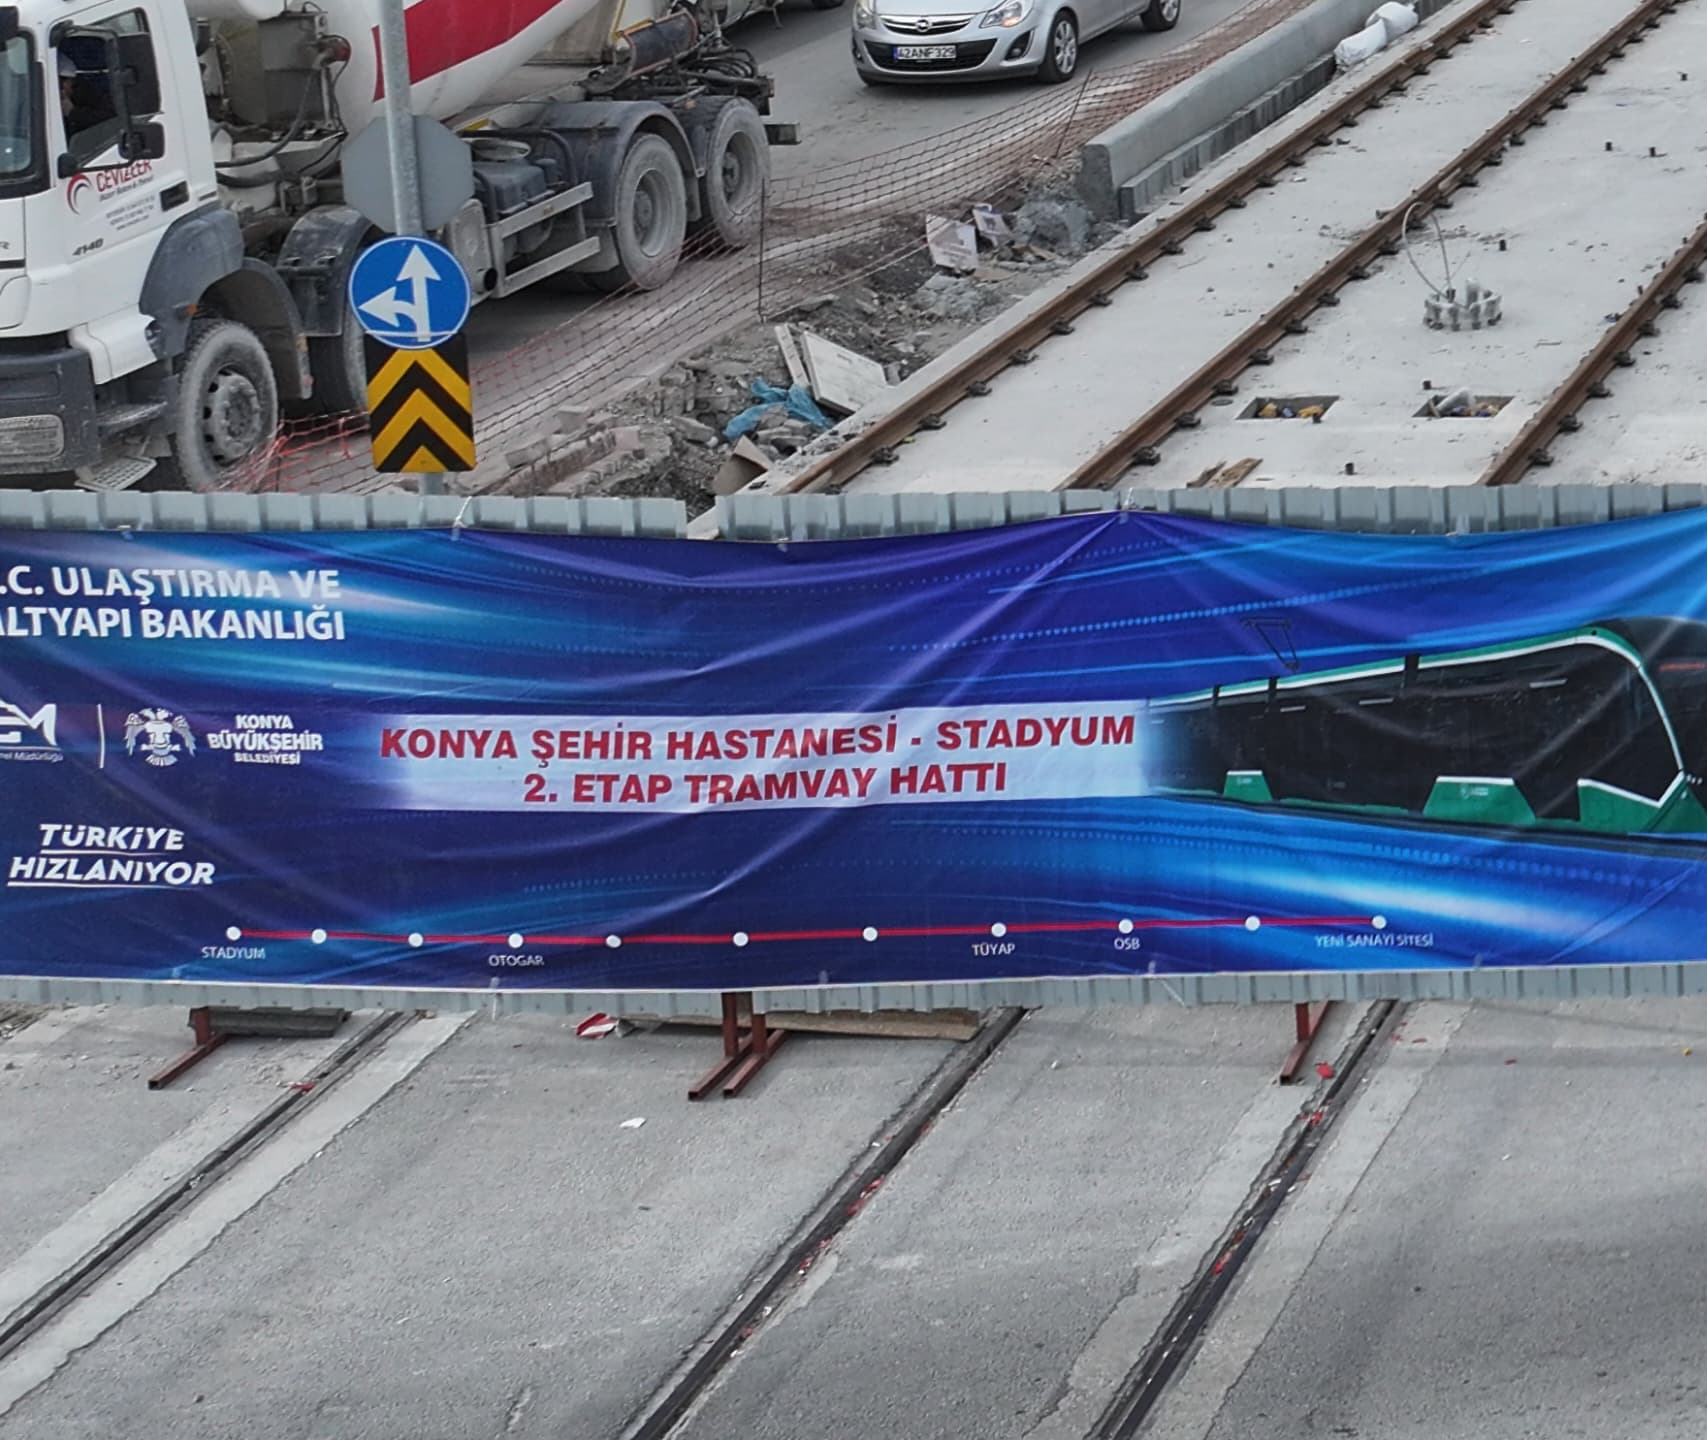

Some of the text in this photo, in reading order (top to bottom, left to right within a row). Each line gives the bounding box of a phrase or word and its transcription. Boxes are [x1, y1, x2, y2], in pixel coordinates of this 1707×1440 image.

[52, 566, 281, 606] ULAŞTIRMA
[290, 570, 342, 599] VE
[0, 605, 346, 641] LTYAPI BAKANLIĞI
[235, 714, 294, 730] KONYA
[207, 731, 324, 753] BÜYÜKŞEHİR
[379, 726, 519, 759] KONYA
[530, 721, 653, 769] ŞEHİR
[666, 714, 899, 762] HASTANESİ
[935, 714, 1136, 750] STADYUM
[233, 749, 302, 766] BELEDİYESİ
[523, 761, 1008, 805] 2. ETAP TRAMVAY HATTI
[39, 822, 185, 852] TÜRKİYE
[8, 855, 216, 886] HIZLANIYOR
[970, 941, 1017, 957] TÜYAP
[1113, 936, 1141, 951] OSB
[1313, 932, 1434, 949] YENİ SANAYİ SİTESİ
[201, 945, 267, 961] STADYUM
[487, 953, 546, 968] OTOGAR
